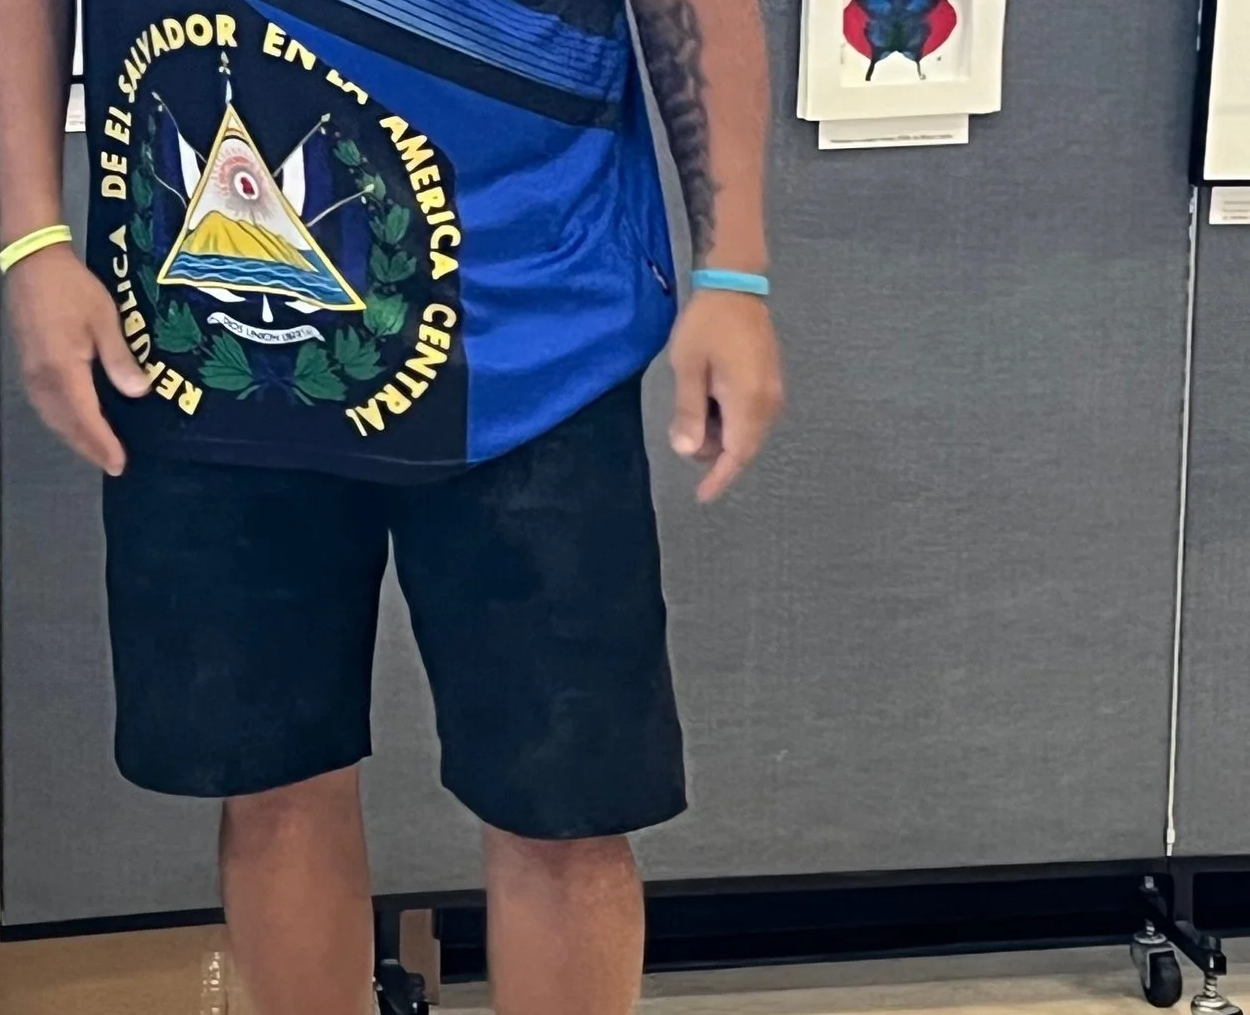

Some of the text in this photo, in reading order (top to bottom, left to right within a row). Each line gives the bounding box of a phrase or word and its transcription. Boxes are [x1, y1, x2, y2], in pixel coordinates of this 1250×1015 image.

[118, 14, 237, 102] SALVADOR
[262, 22, 316, 70] EN
[103, 106, 131, 143] EL
[100, 151, 128, 200] DE
[379, 116, 461, 280] AMERICA
